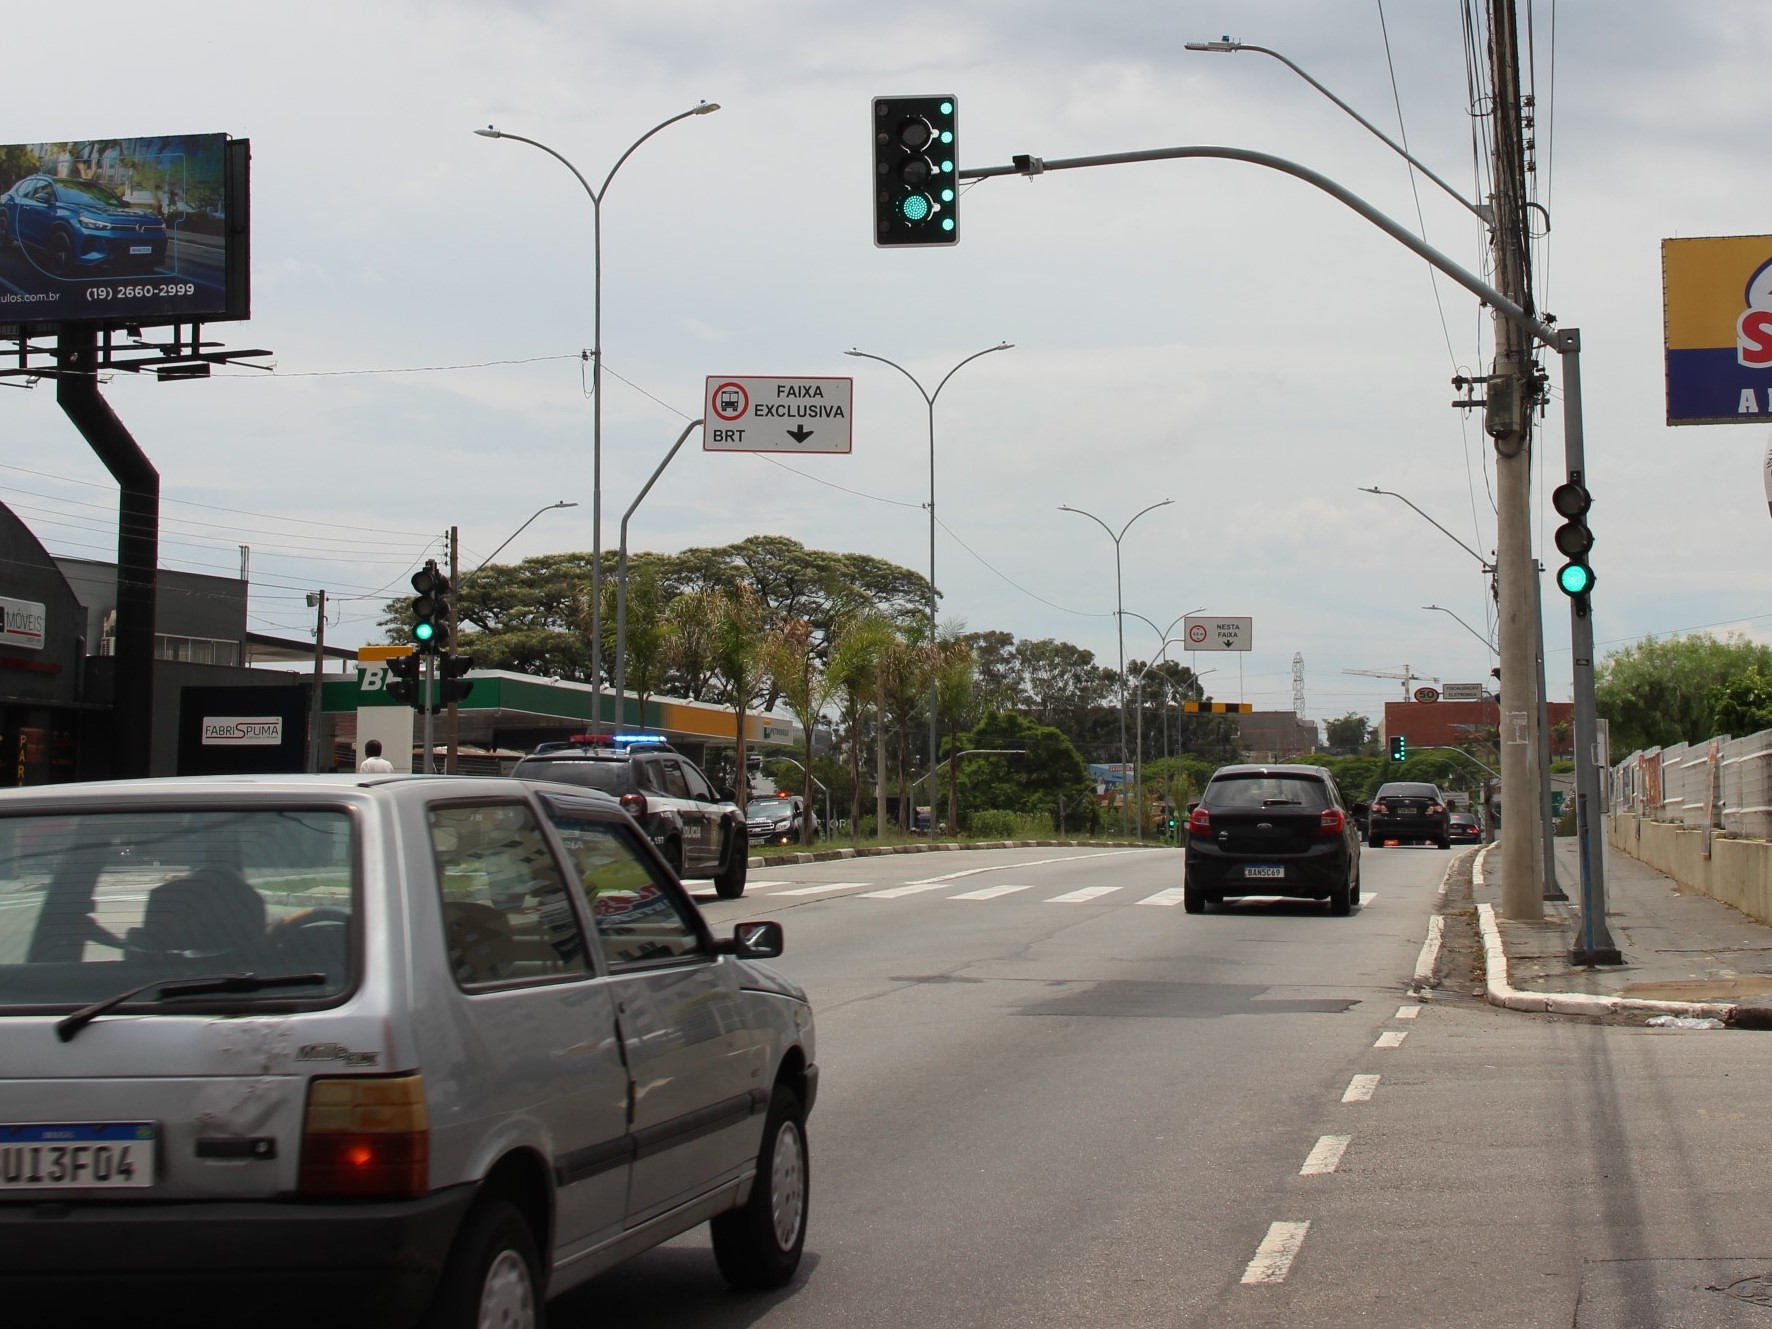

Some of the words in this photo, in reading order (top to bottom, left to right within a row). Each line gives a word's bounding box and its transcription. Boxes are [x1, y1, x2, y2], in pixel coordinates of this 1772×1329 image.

[0, 291, 60, 303] ulos.com.br
[86, 286, 113, 301] (19)
[117, 283, 195, 299] 2660-2999
[776, 385, 824, 399] FAIXA
[754, 404, 845, 419] EXCLUSIVA
[713, 429, 746, 443] BRT
[6, 608, 43, 632] MÓVEIS
[1419, 690, 1435, 699] 50
[205, 722, 279, 739] FABRISPUMA
[16, 735, 28, 787] PAR
[0, 1143, 137, 1183] UI3F04
